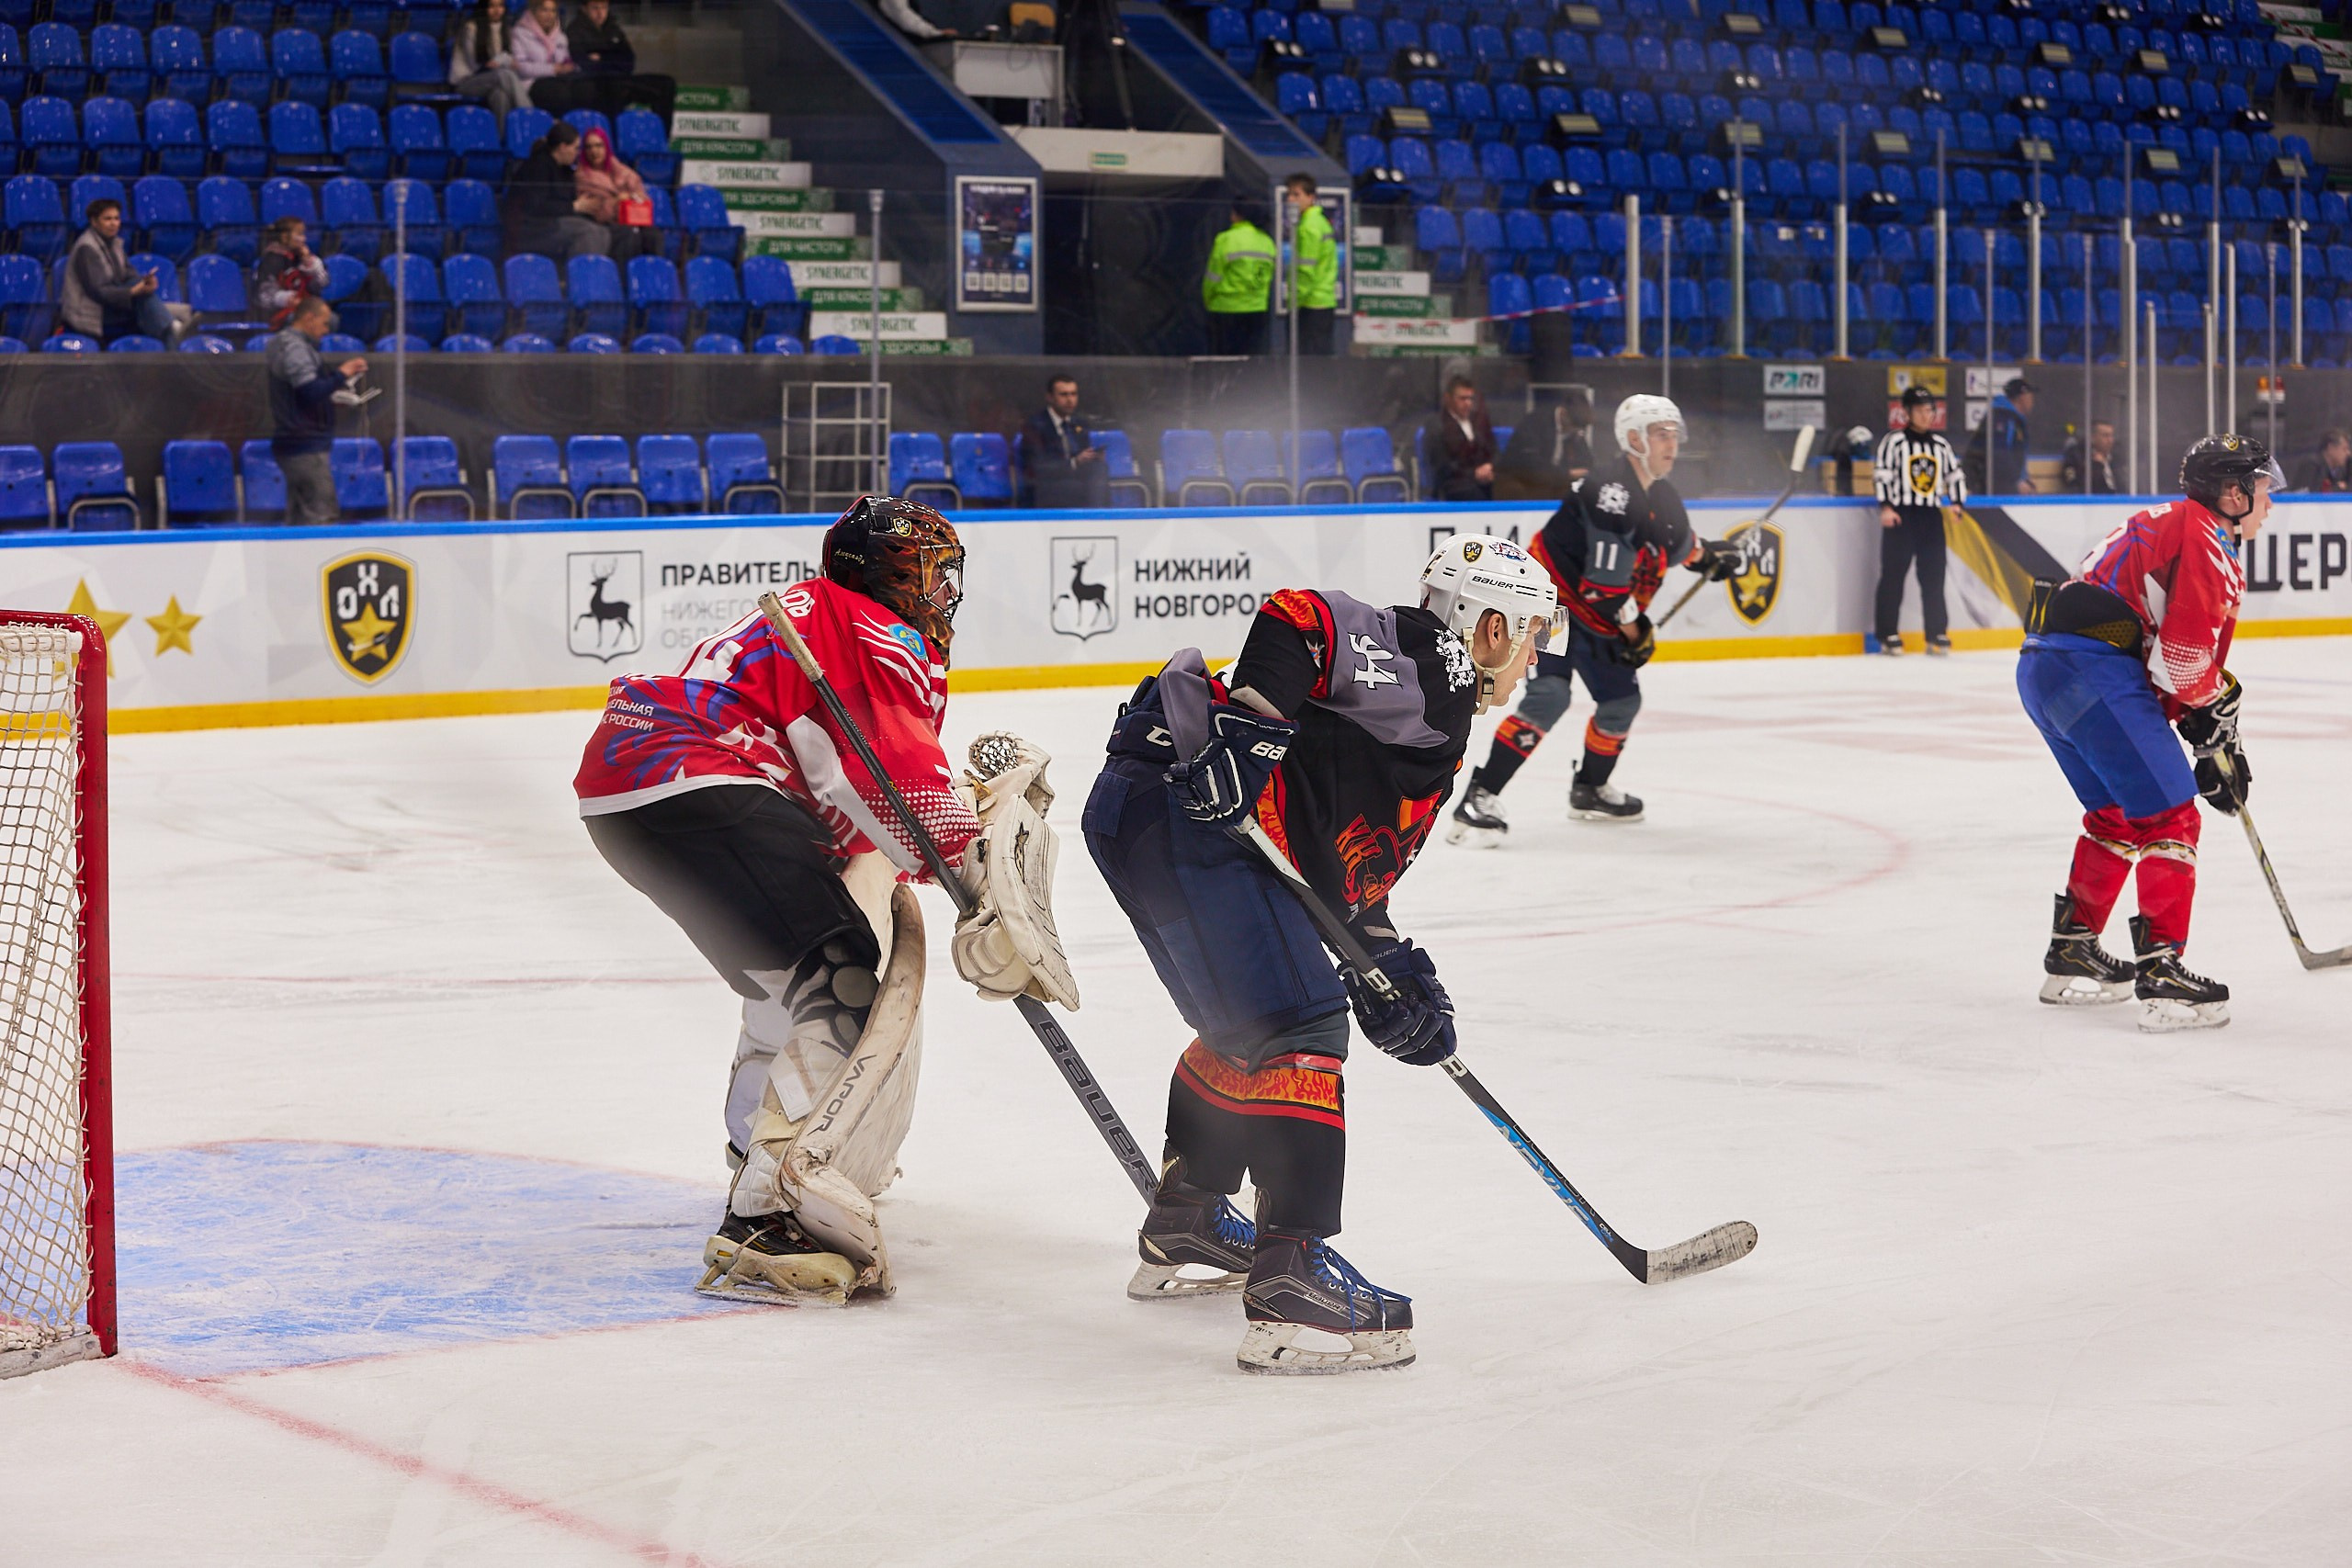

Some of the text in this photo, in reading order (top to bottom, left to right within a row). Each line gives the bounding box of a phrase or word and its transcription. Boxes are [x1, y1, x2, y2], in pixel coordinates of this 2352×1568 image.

[674, 93, 718, 105] ИСТОТЫ
[677, 117, 740, 131] SYNERGETIC
[717, 166, 780, 181] SYNERGETIC
[759, 216, 823, 230] SYNERGETIC
[806, 265, 868, 279] SYNERGETIC
[1354, 276, 1403, 288] YNERGETIC
[838, 292, 891, 304] КРАСОЫ
[850, 318, 917, 332] SYNRGETIC
[1595, 540, 1619, 571] 11
[2246, 534, 2352, 592] ЦЕР
[662, 561, 818, 586] ПРАВИТЕЛЬ
[1135, 551, 1250, 582] НИЖНИЙ
[1472, 575, 1514, 590] BAUER
[336, 563, 401, 620] ОХЛ
[661, 598, 759, 621] НИЖЕГО
[609, 713, 655, 732] РОССИИ
[807, 1054, 877, 1137] VAPOR
